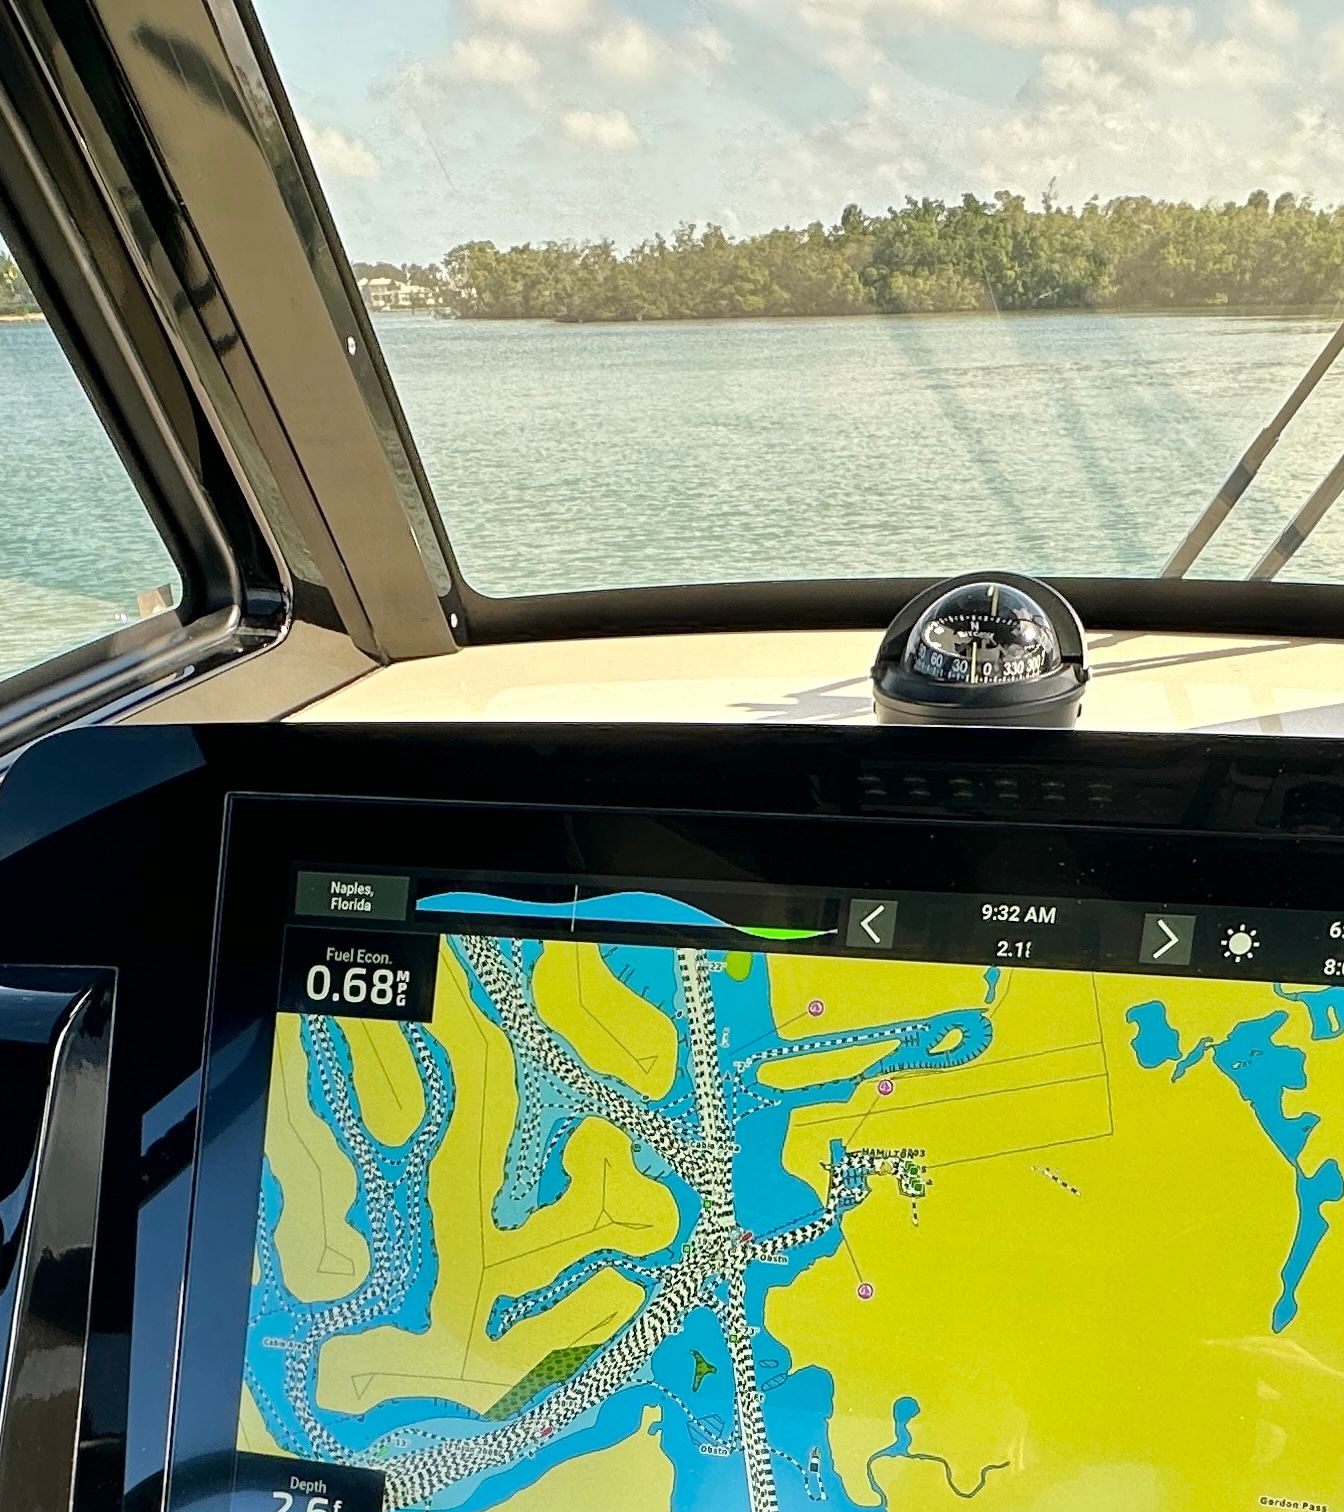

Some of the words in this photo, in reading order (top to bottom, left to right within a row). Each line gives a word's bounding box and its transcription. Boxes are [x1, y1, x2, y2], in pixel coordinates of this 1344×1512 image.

[930, 652, 943, 667] 60
[952, 659, 968, 674] 30
[1004, 661, 1024, 675] 330
[330, 881, 375, 897] Naples,
[330, 897, 373, 912] Florida
[981, 903, 1021, 922] 9:32
[1023, 906, 1057, 924] AM
[326, 946, 355, 962] Fuel
[356, 948, 393, 965] Econ.
[996, 940, 1023, 958] 2.1
[306, 964, 395, 1005] 0.68
[290, 1475, 327, 1494] Depth
[1301, 1502, 1327, 1512] Pass
